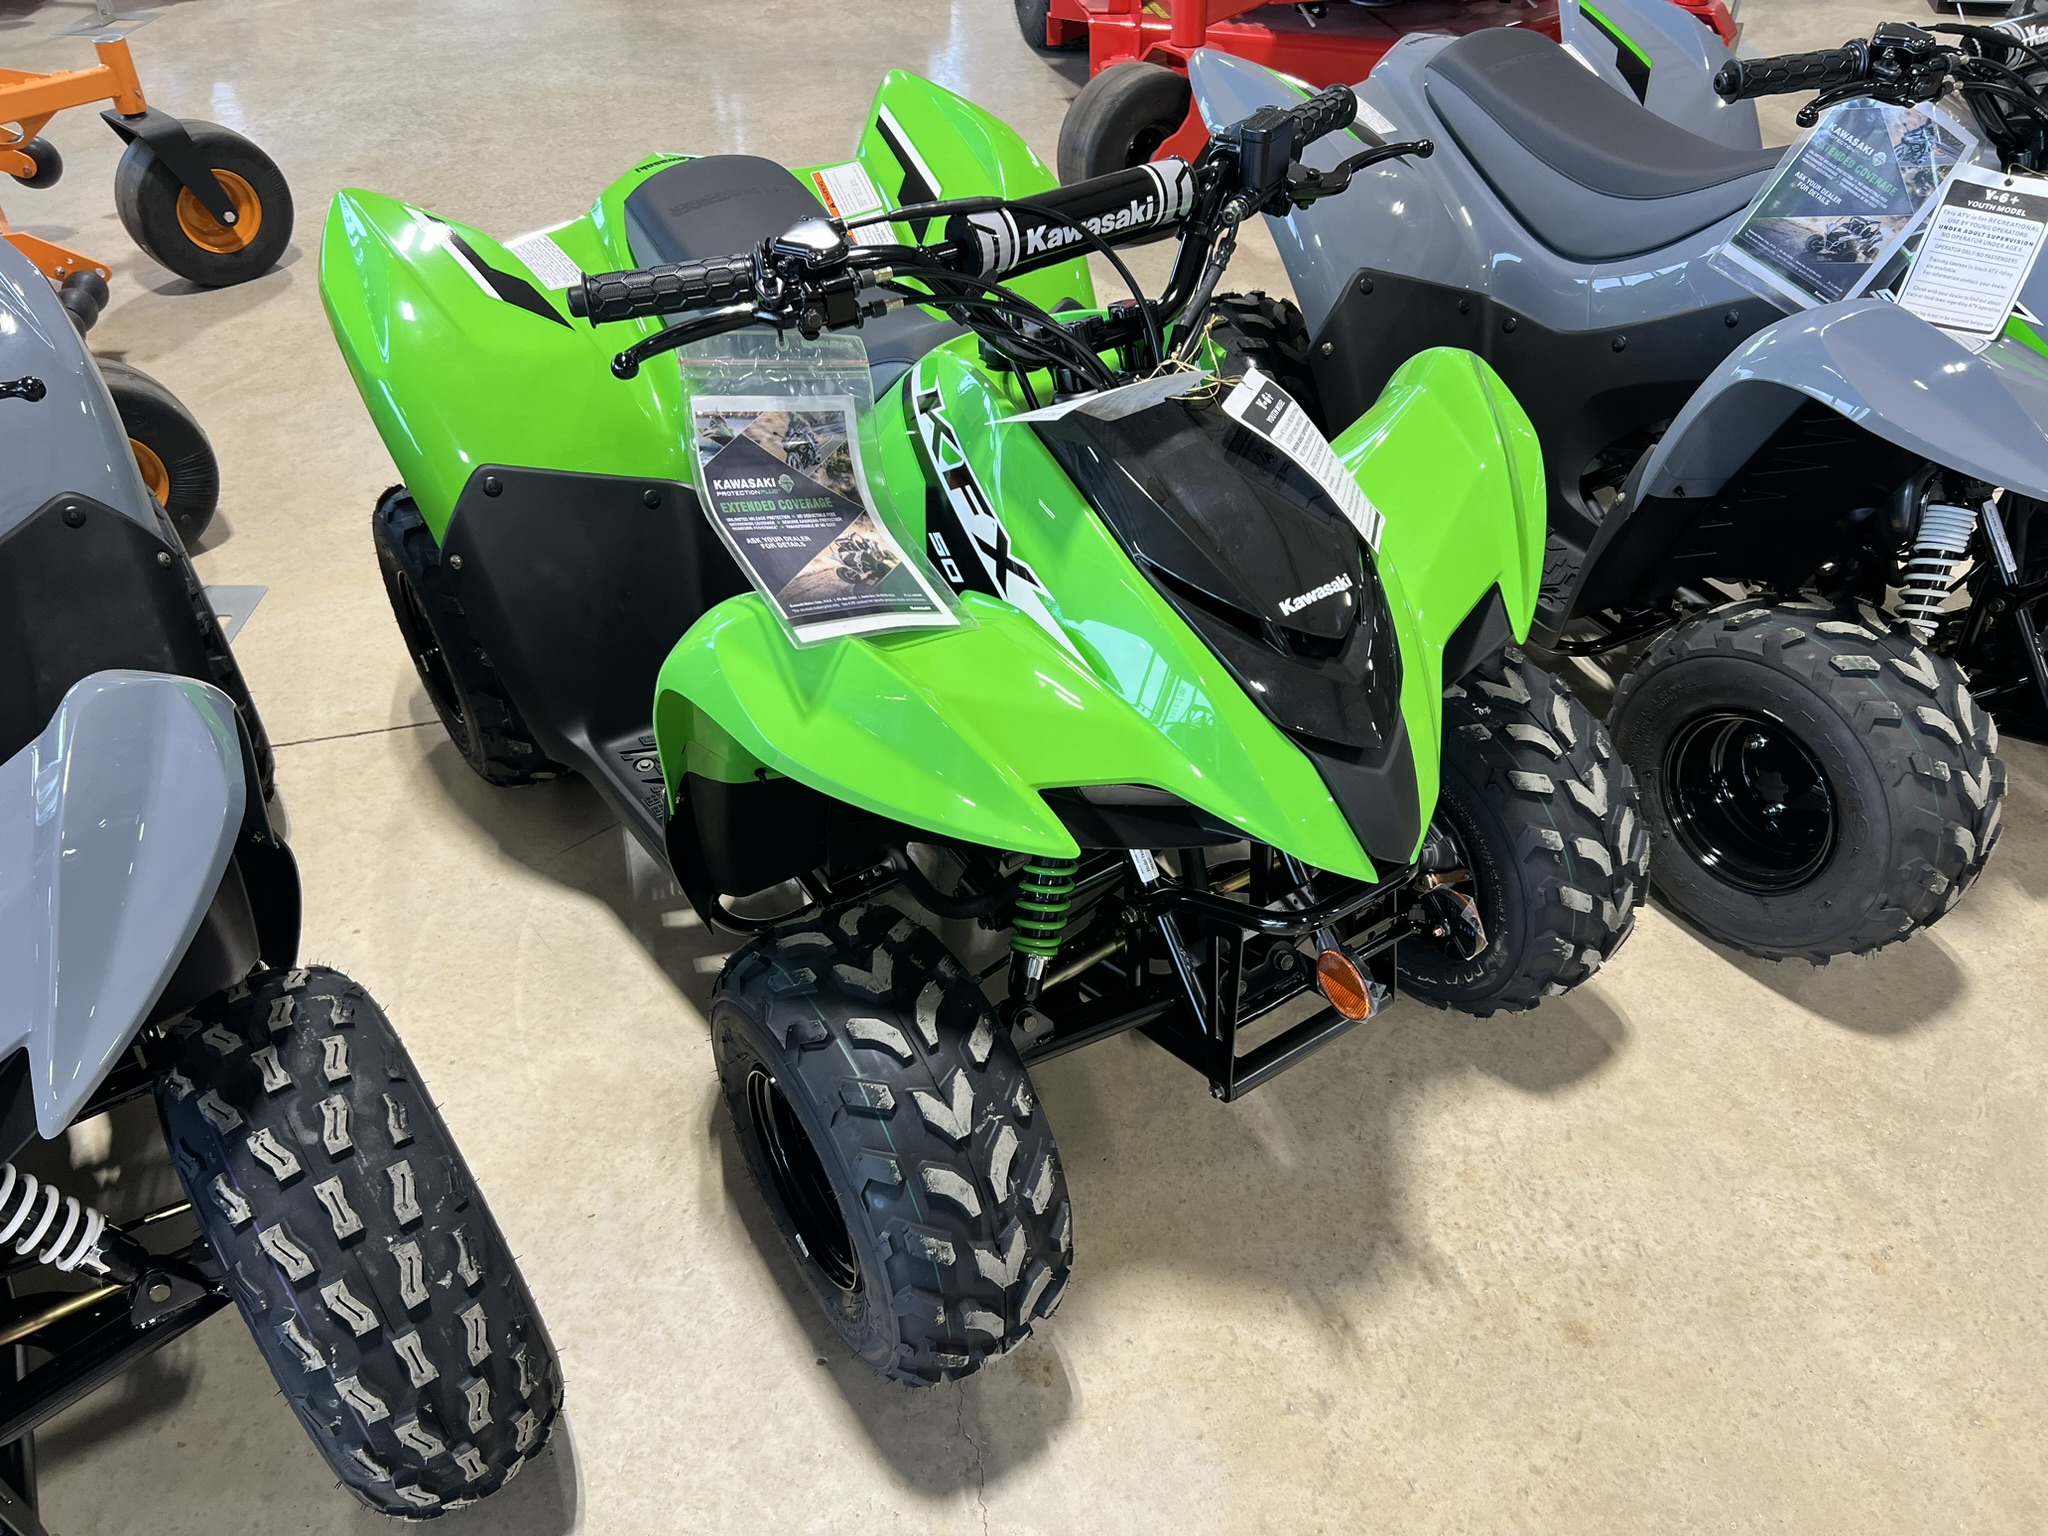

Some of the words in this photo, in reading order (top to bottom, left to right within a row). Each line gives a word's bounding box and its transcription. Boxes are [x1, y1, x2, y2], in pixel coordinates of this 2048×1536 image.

[1829, 123, 1874, 156] KAWASAKI
[1794, 171, 1807, 182] ASK
[1806, 178, 1823, 194] YOUR
[1820, 188, 1842, 205] DEALER
[1855, 164, 1898, 197] COVERAGE
[1796, 182, 1810, 194] FOR
[1808, 188, 1830, 206] DETAILS
[1967, 200, 1995, 211] YOUTH
[1996, 204, 2026, 216] MODEL
[1026, 196, 1154, 255] Kawasaki
[1958, 211, 1970, 219] ATV
[1989, 217, 2040, 232] RECREATIONAL
[1970, 222, 1991, 230] YOUNG
[1992, 225, 2028, 238] OPERATORS
[1939, 224, 1961, 233] UNDER
[1963, 228, 1986, 238] ADULT
[1986, 233, 2034, 246] SUPERVISION
[1951, 233, 1983, 245] OPERATOR
[1983, 240, 2004, 248] UNDER
[2004, 244, 2018, 252] AGE
[1929, 256, 1949, 265] Training
[1934, 243, 1961, 253] OPERATOR
[1984, 251, 2018, 264] PASSENGERS
[713, 478, 776, 490] KAWASAKI
[913, 382, 1043, 600] KFX
[720, 500, 776, 513] EXTENDED
[778, 498, 833, 510] COVERAGE
[746, 536, 761, 544] ASK
[928, 532, 964, 583] 50
[1278, 572, 1353, 617] Kawasaki
